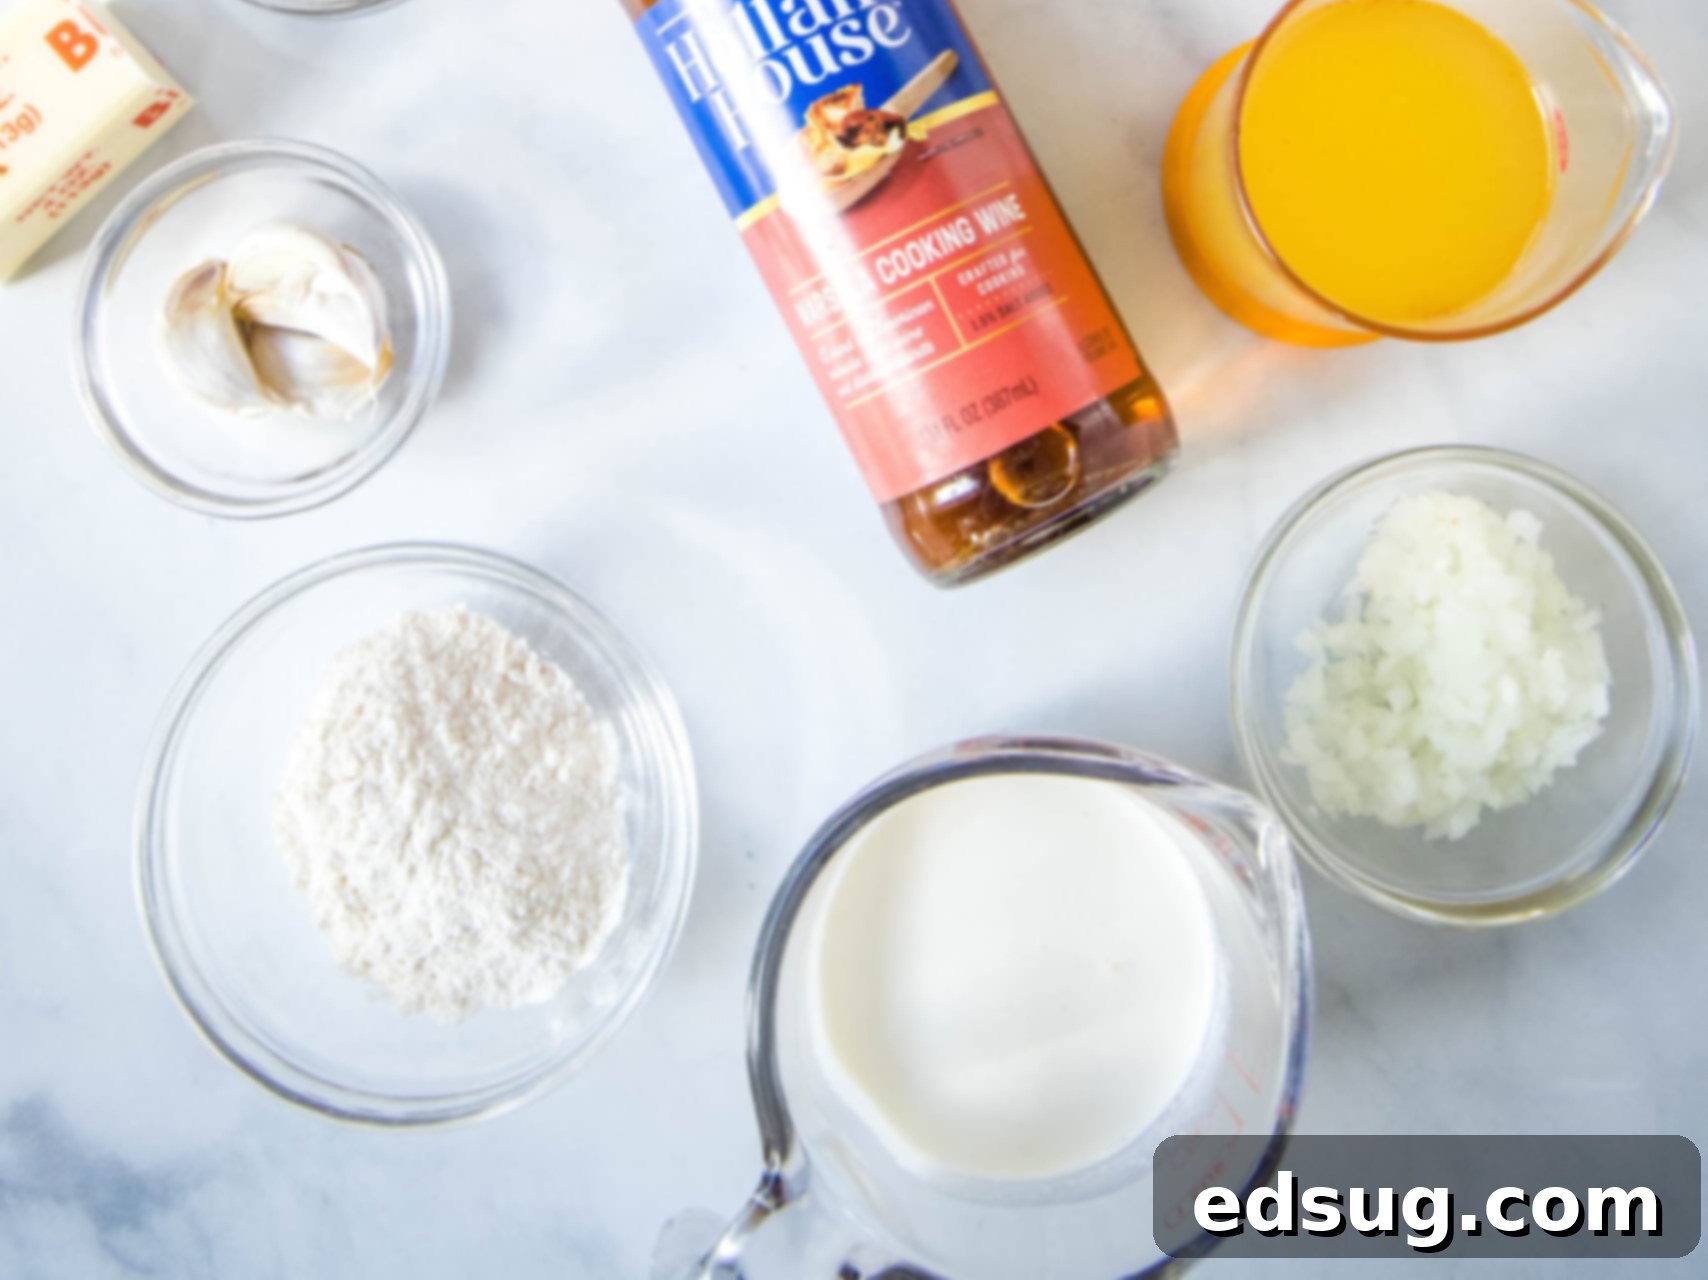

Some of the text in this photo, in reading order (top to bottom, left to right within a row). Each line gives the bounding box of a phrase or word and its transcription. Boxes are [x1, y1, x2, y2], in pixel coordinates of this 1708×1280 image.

[44, 19, 99, 73] B
[875, 217, 975, 284] COOKING
[973, 193, 1026, 235] WINE
